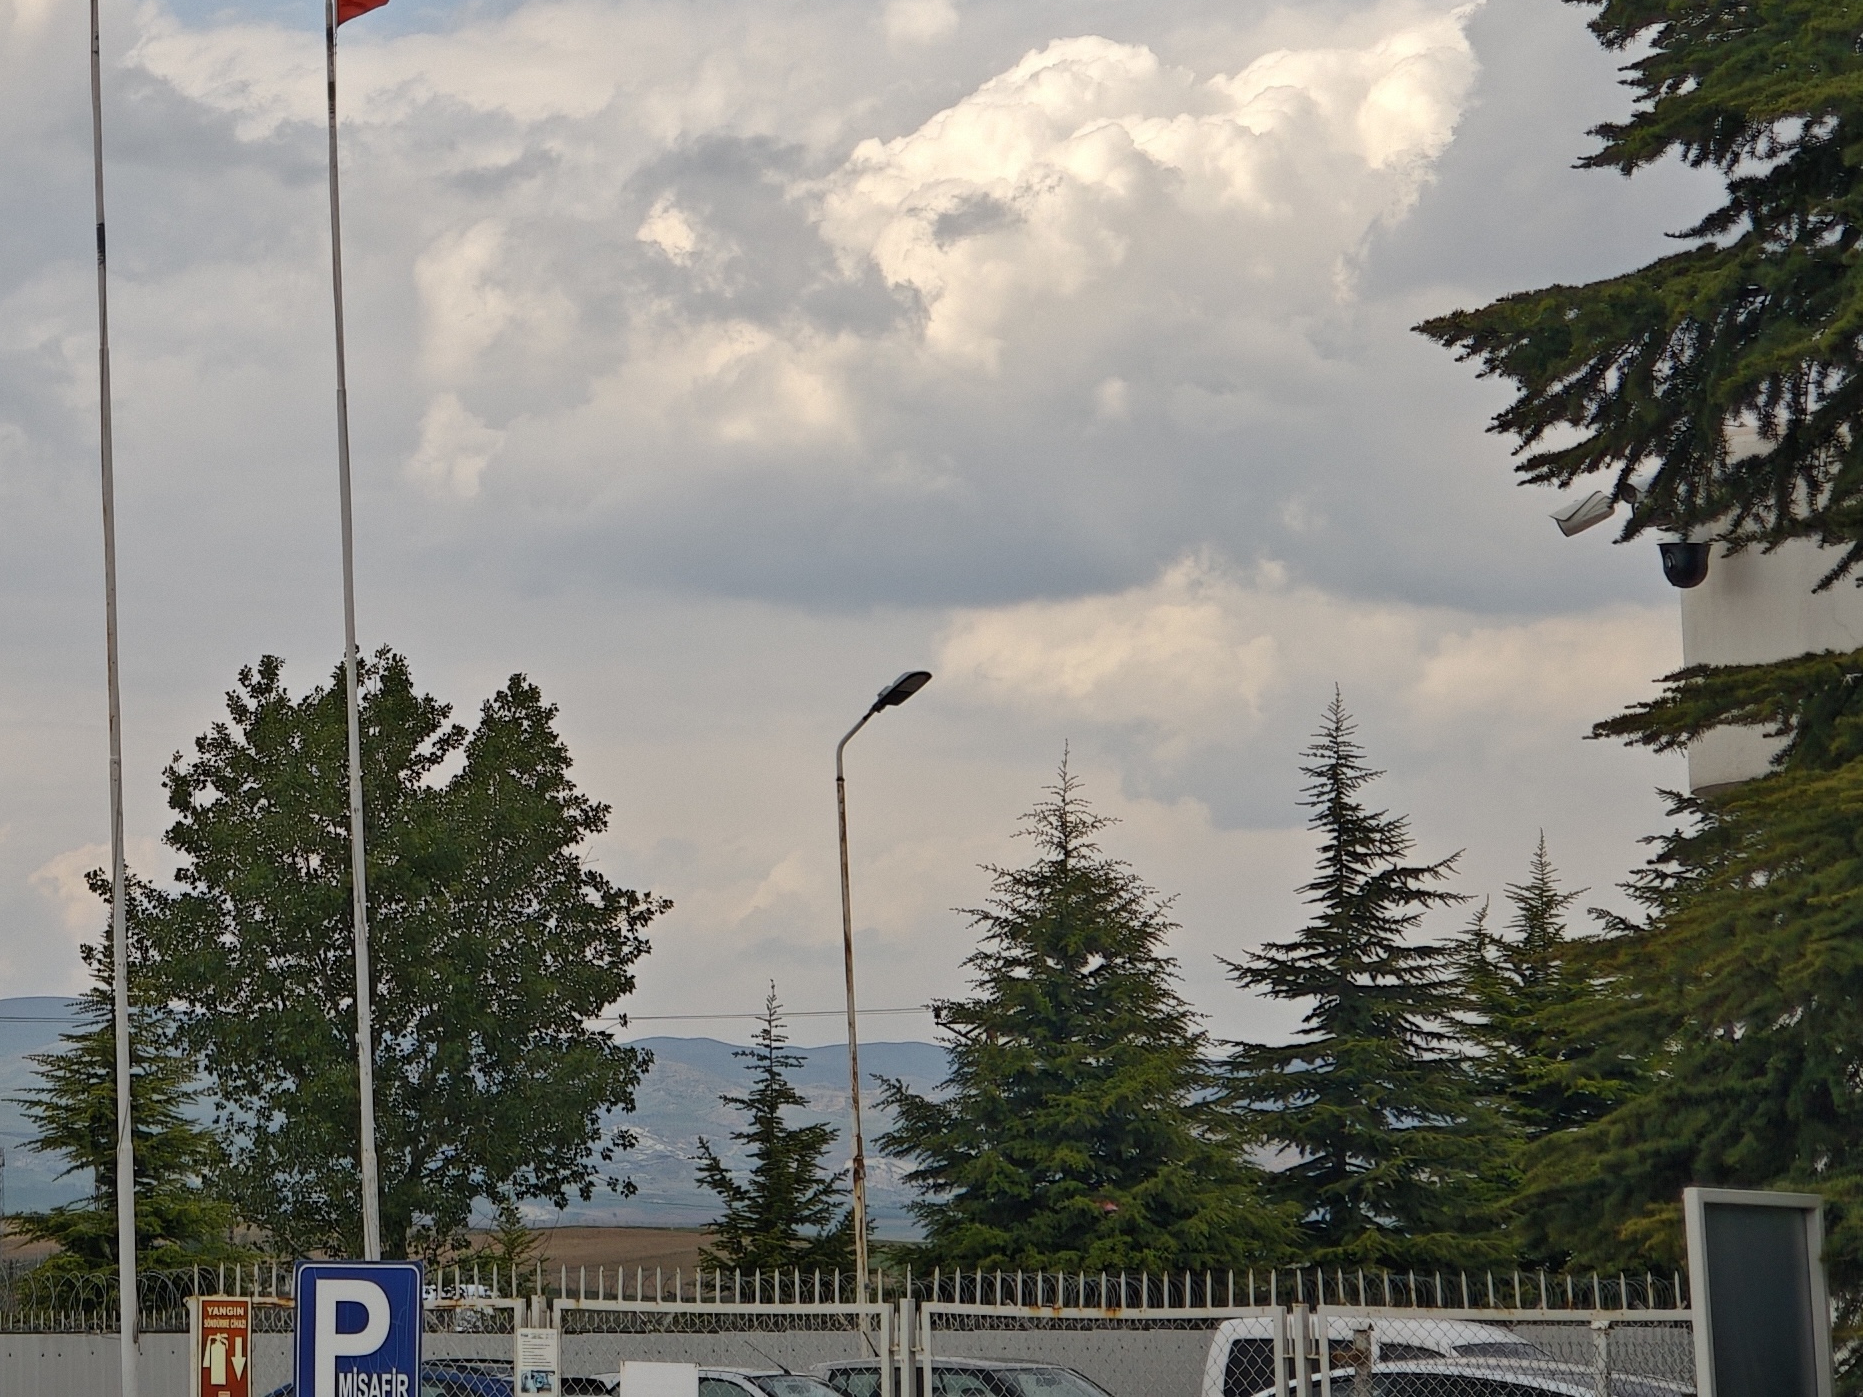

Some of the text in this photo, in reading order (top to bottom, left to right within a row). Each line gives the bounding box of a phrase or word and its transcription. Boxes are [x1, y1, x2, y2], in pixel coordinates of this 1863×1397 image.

[207, 1306, 245, 1316] YANGIN
[315, 1279, 390, 1397] P
[338, 1367, 409, 1397] MİSAFİR
